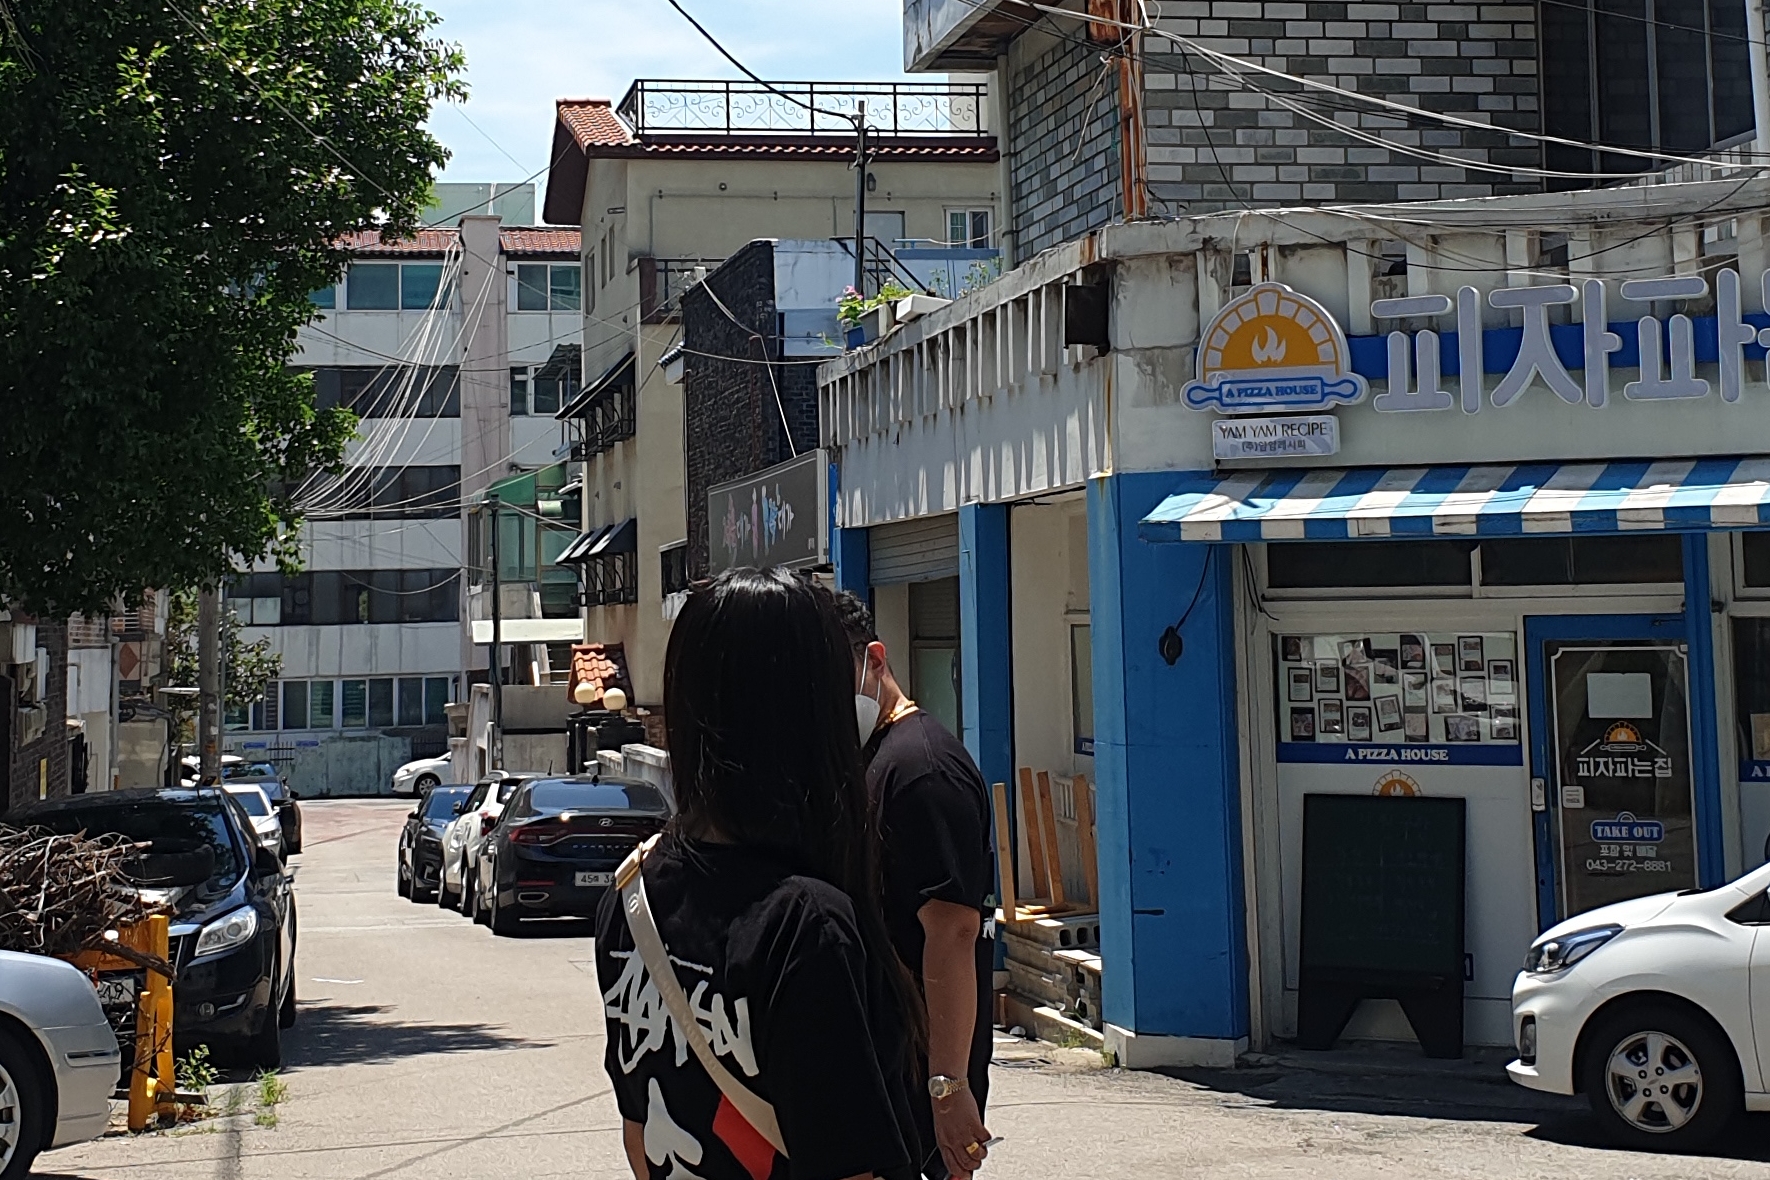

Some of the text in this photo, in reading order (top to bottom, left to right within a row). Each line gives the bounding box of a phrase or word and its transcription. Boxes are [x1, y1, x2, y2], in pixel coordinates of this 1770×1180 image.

[1371, 267, 1769, 415] 피자파
[1226, 384, 1319, 398] A PIZZA HOUSE
[1219, 421, 1328, 439] YAM YAM RECIPE
[1345, 748, 1449, 761] A PIZZA HOUSE
[1576, 757, 1673, 778] 피자파는집
[1594, 825, 1660, 838] TAKE OUT
